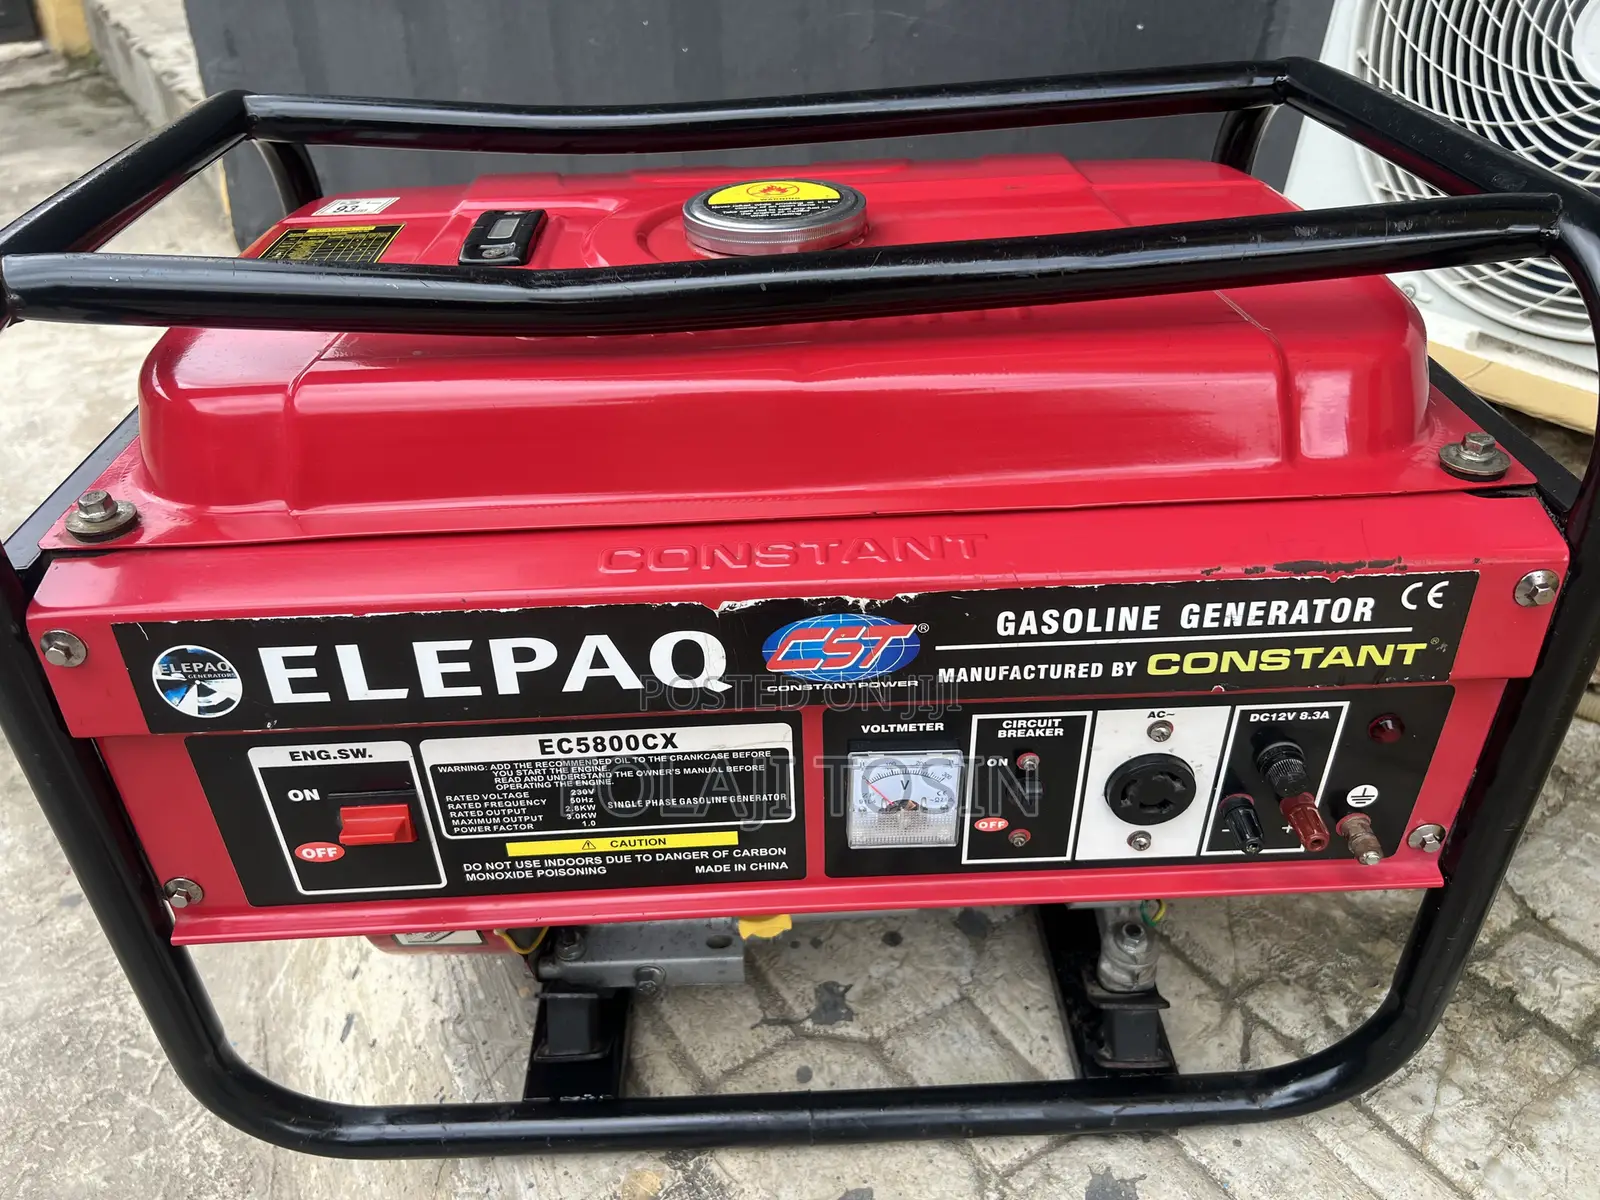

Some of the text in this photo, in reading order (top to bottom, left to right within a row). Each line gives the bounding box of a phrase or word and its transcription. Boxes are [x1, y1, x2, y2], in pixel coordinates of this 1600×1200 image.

[597, 533, 989, 575] CONSTANT
[996, 597, 1376, 636] GASOLINE GENERATOR
[766, 624, 917, 672] CST
[1147, 642, 1428, 676] CONSTANT
[159, 661, 232, 674] ELEPAQ
[257, 630, 733, 704] ELEPAQ
[938, 661, 1137, 684] MANUFACTURED BY
[767, 680, 919, 692] CONSTANT POWER
[1002, 718, 1062, 729] CIRCUIT
[1249, 710, 1330, 723] DC12V 8.3A
[860, 722, 945, 734] VOLTMETER
[997, 727, 1064, 739] BREAKER
[538, 732, 679, 755] EC5800CX
[288, 748, 373, 763] ENG.SW.
[437, 750, 772, 773] WARNING: ADD THE RECOMMENDED OIL TO THE CRANKCASE BEFORE
[987, 758, 1009, 767] ON
[494, 776, 522, 784] READ
[523, 775, 545, 783] AND
[547, 772, 612, 781] UNDERSTAND
[636, 768, 682, 777] OWNER'S
[683, 766, 724, 775] MANUAL
[726, 764, 766, 773] BEFORE
[516, 768, 548, 777] START
[549, 767, 570, 775] THE
[571, 765, 611, 773] ENGINE.
[495, 778, 615, 791] OPERATING THE ENGINE.
[900, 780, 910, 791] V
[287, 789, 321, 802] ON
[445, 788, 595, 802] RATED VOLTAGE 230V
[607, 793, 788, 809] SINGLE PHASE GASOLINE GENERATOR
[447, 802, 482, 810] RATED
[484, 799, 548, 808] FREQUENCY
[449, 804, 596, 818] RATED OUTPUT 2.8KW
[452, 812, 597, 826] MAXIMUM OUTPUT 3.0KW
[978, 821, 1006, 829] OFF
[453, 825, 492, 834] POWER
[493, 823, 535, 831] FACTOR
[610, 838, 667, 849] CAUTION
[301, 847, 338, 859] OFF
[463, 847, 787, 872] DO NOT USE INDOORS DUE TO DANGER OF CARBON
[465, 866, 608, 882] MONOXIDE POISONING
[694, 861, 789, 875] MADE IN CHINA
